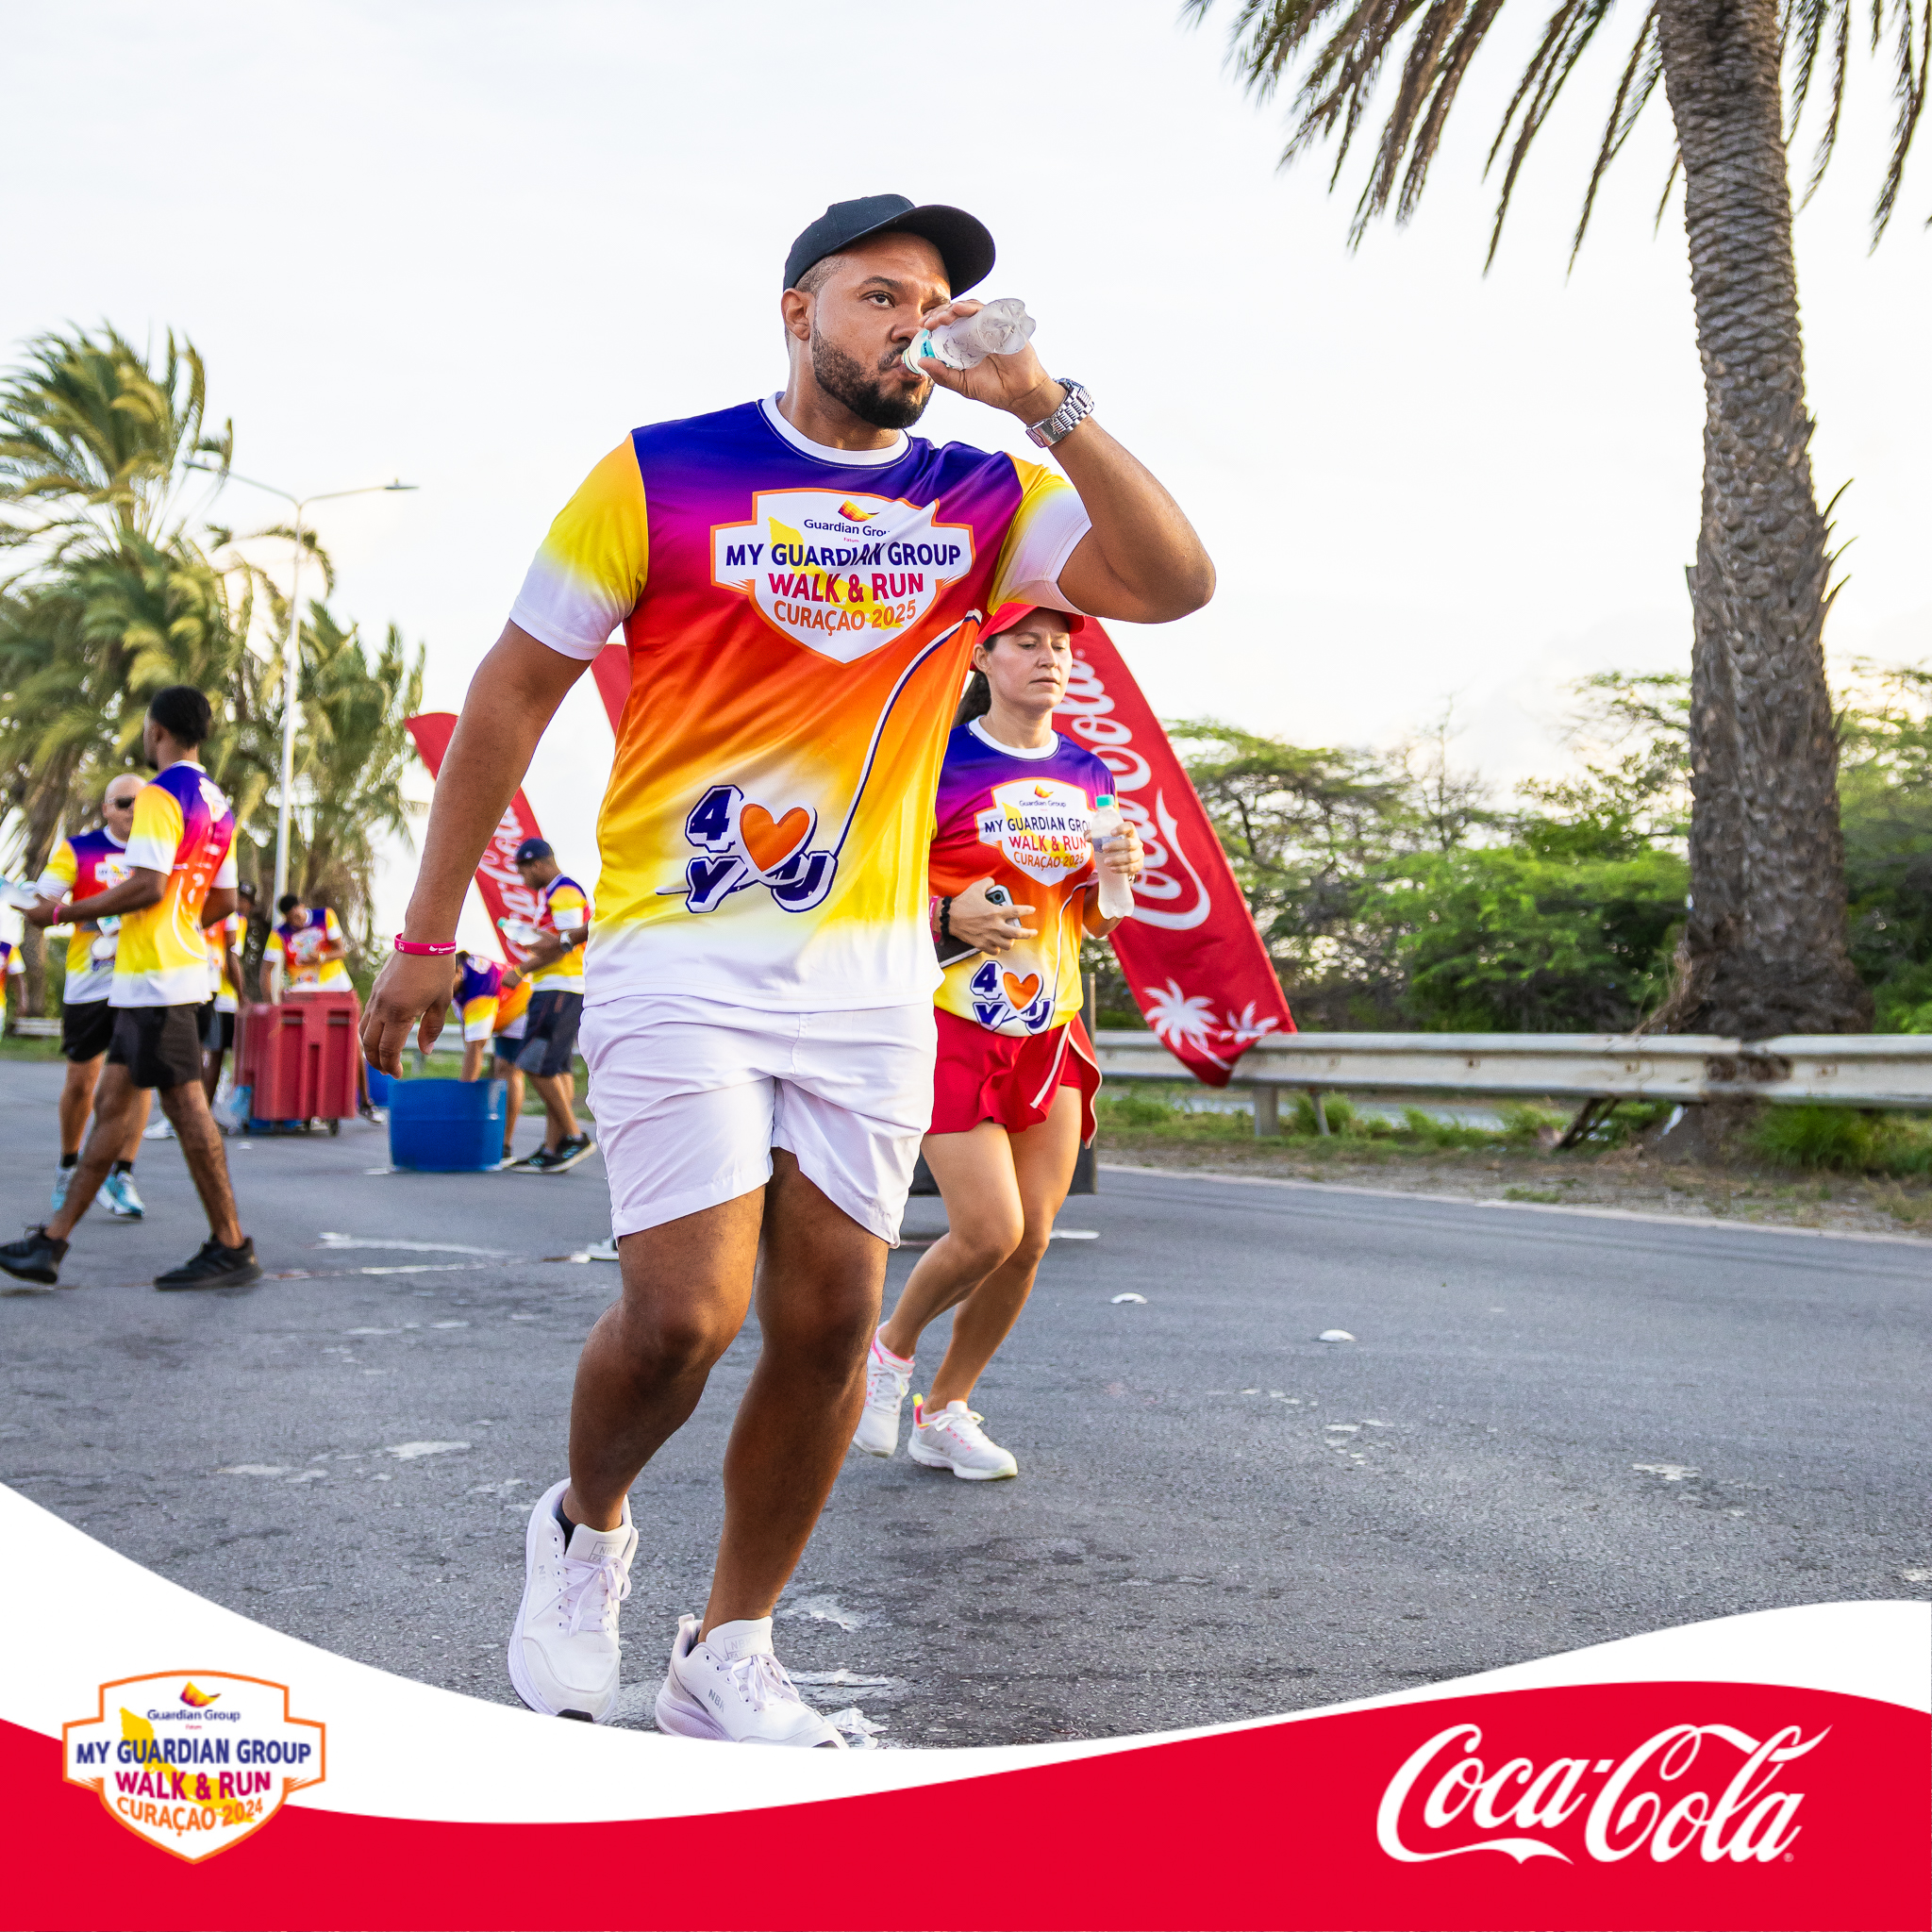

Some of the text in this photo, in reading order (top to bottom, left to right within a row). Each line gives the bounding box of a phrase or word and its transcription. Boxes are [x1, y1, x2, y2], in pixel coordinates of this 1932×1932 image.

[804, 519, 891, 538] Guardian Gro
[725, 541, 961, 568] MY GUARDIAN GROUP
[768, 573, 924, 603] WALK & RUN
[774, 599, 917, 637] CURAÇAO 2025
[1047, 800, 1067, 808] Group
[1053, 658, 1211, 930] CocaCola
[985, 816, 1091, 833] MY GUARDIAN GRO
[1008, 835, 1087, 852] WALK & RUN
[1013, 851, 1085, 872] CURAÇAO 2025
[708, 1689, 725, 1714] NBK
